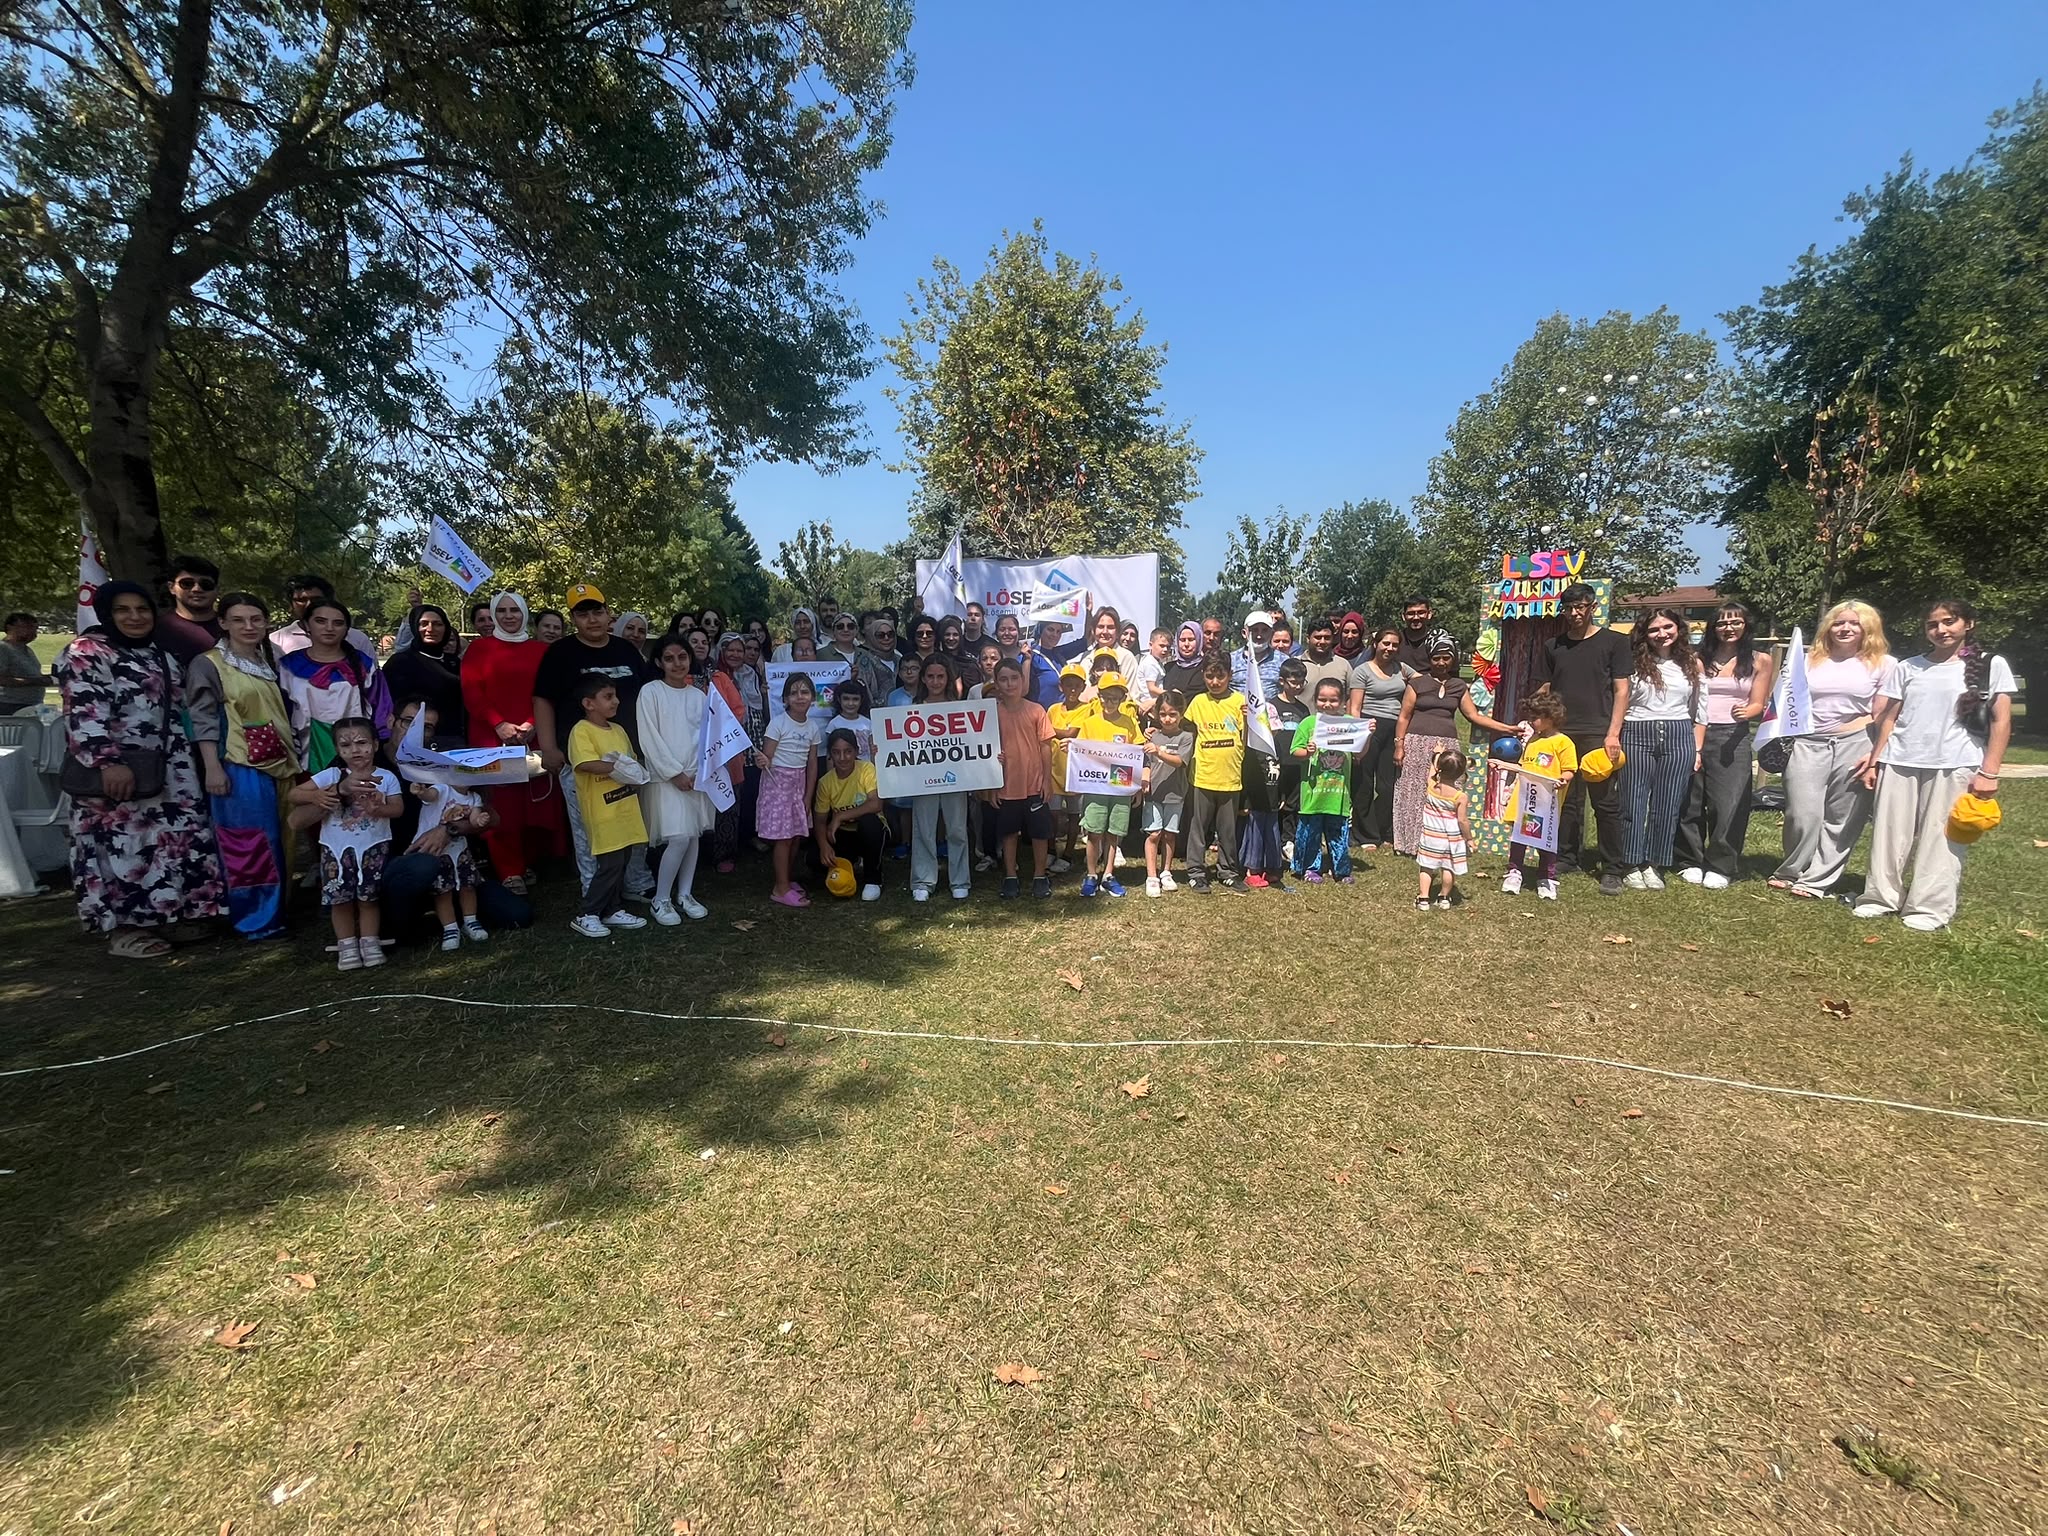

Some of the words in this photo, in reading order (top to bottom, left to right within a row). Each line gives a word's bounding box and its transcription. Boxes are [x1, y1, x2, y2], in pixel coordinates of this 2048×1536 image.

[986, 588, 1032, 606] LÖSE
[884, 710, 987, 740] LÖSEV
[885, 743, 992, 768] ANADOLU
